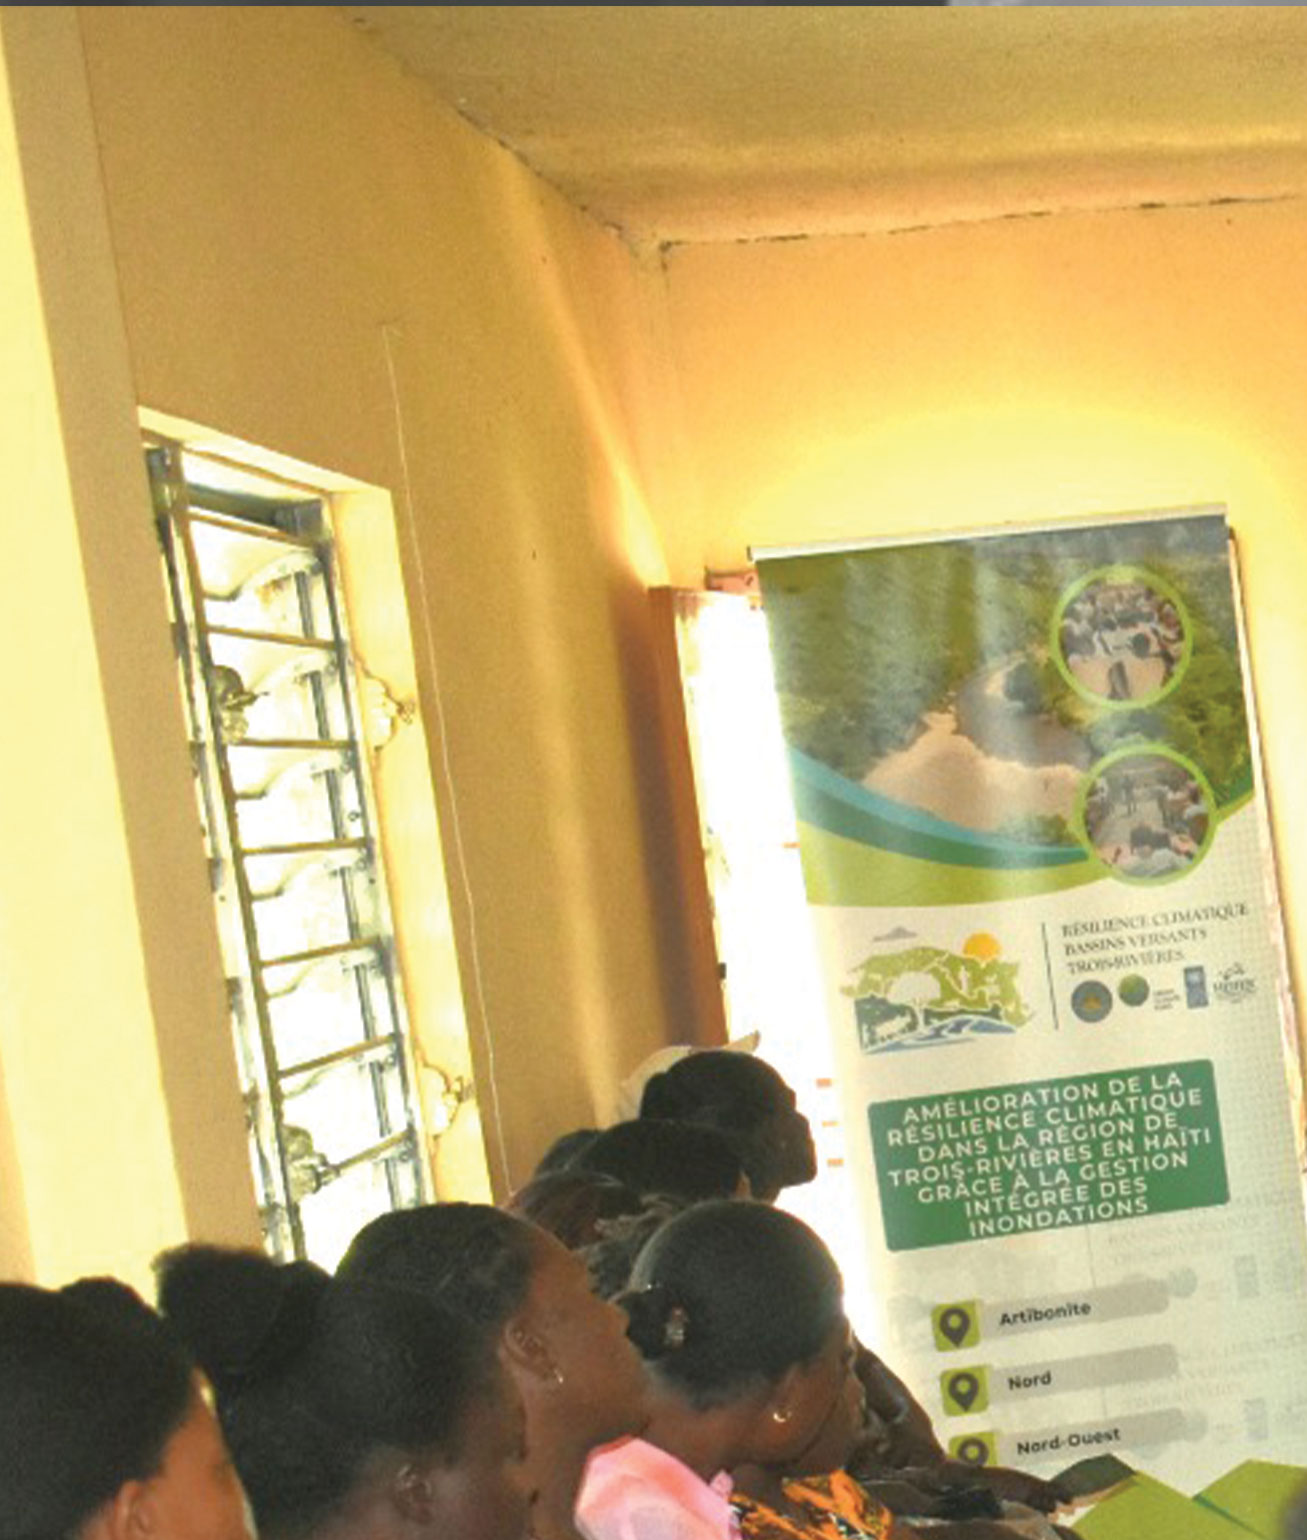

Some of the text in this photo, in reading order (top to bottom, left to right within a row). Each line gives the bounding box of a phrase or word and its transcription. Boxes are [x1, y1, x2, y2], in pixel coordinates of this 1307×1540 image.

[1061, 903, 1249, 938] RÉSILIENCE CLIMATIQUE
[1064, 928, 1207, 957] BASSINS VERSANTS
[887, 1088, 1202, 1147] RÉSILIENCE CLIMATIQUE
[903, 1072, 1183, 1125] AMÉLIORATION DE LA
[888, 1126, 1212, 1188] TROIS-RIVIÈRES EN HAÏTI
[918, 1112, 1178, 1164] DANS LA RÉGION DE
[918, 1152, 1189, 1204] GRÂCE À LA GESTION
[966, 1177, 1148, 1218] INTÉGRÉE DES
[969, 1197, 1149, 1238] INONDATIONS
[999, 1302, 1092, 1327] Artibonite
[1008, 1370, 1052, 1391] Nord
[1017, 1428, 1121, 1455] Nord-Ouest
